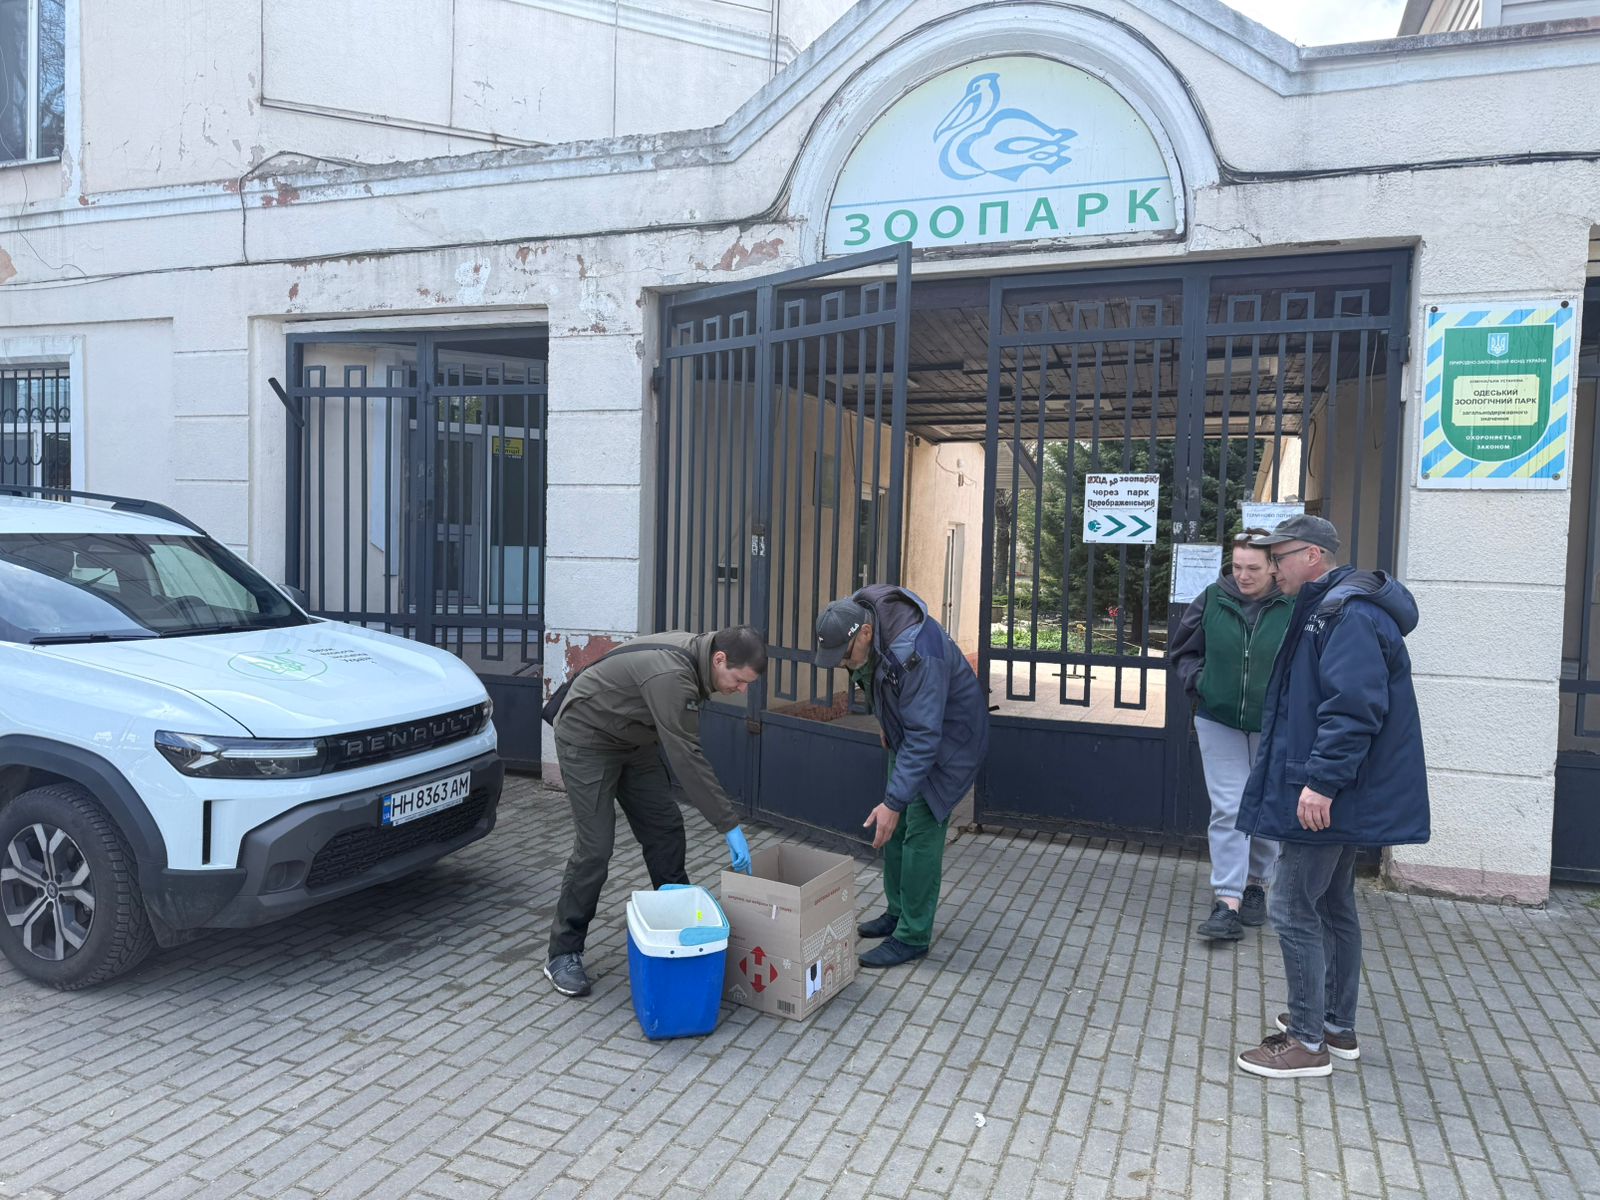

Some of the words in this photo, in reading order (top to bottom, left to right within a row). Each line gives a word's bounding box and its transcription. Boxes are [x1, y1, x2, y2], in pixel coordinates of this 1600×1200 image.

[843, 187, 1162, 246] ЗООПАРК
[1473, 389, 1518, 397] ОДЕСЬКИЙ
[1455, 397, 1513, 405] ЗООЛОГІЧНИЙ
[1092, 489, 1119, 497] через
[1127, 489, 1150, 497] парк
[1087, 498, 1156, 507] Преображенський
[346, 713, 474, 757] RENAULT
[391, 791, 414, 818] HH
[416, 781, 448, 809] 8363
[450, 775, 469, 799] AM
